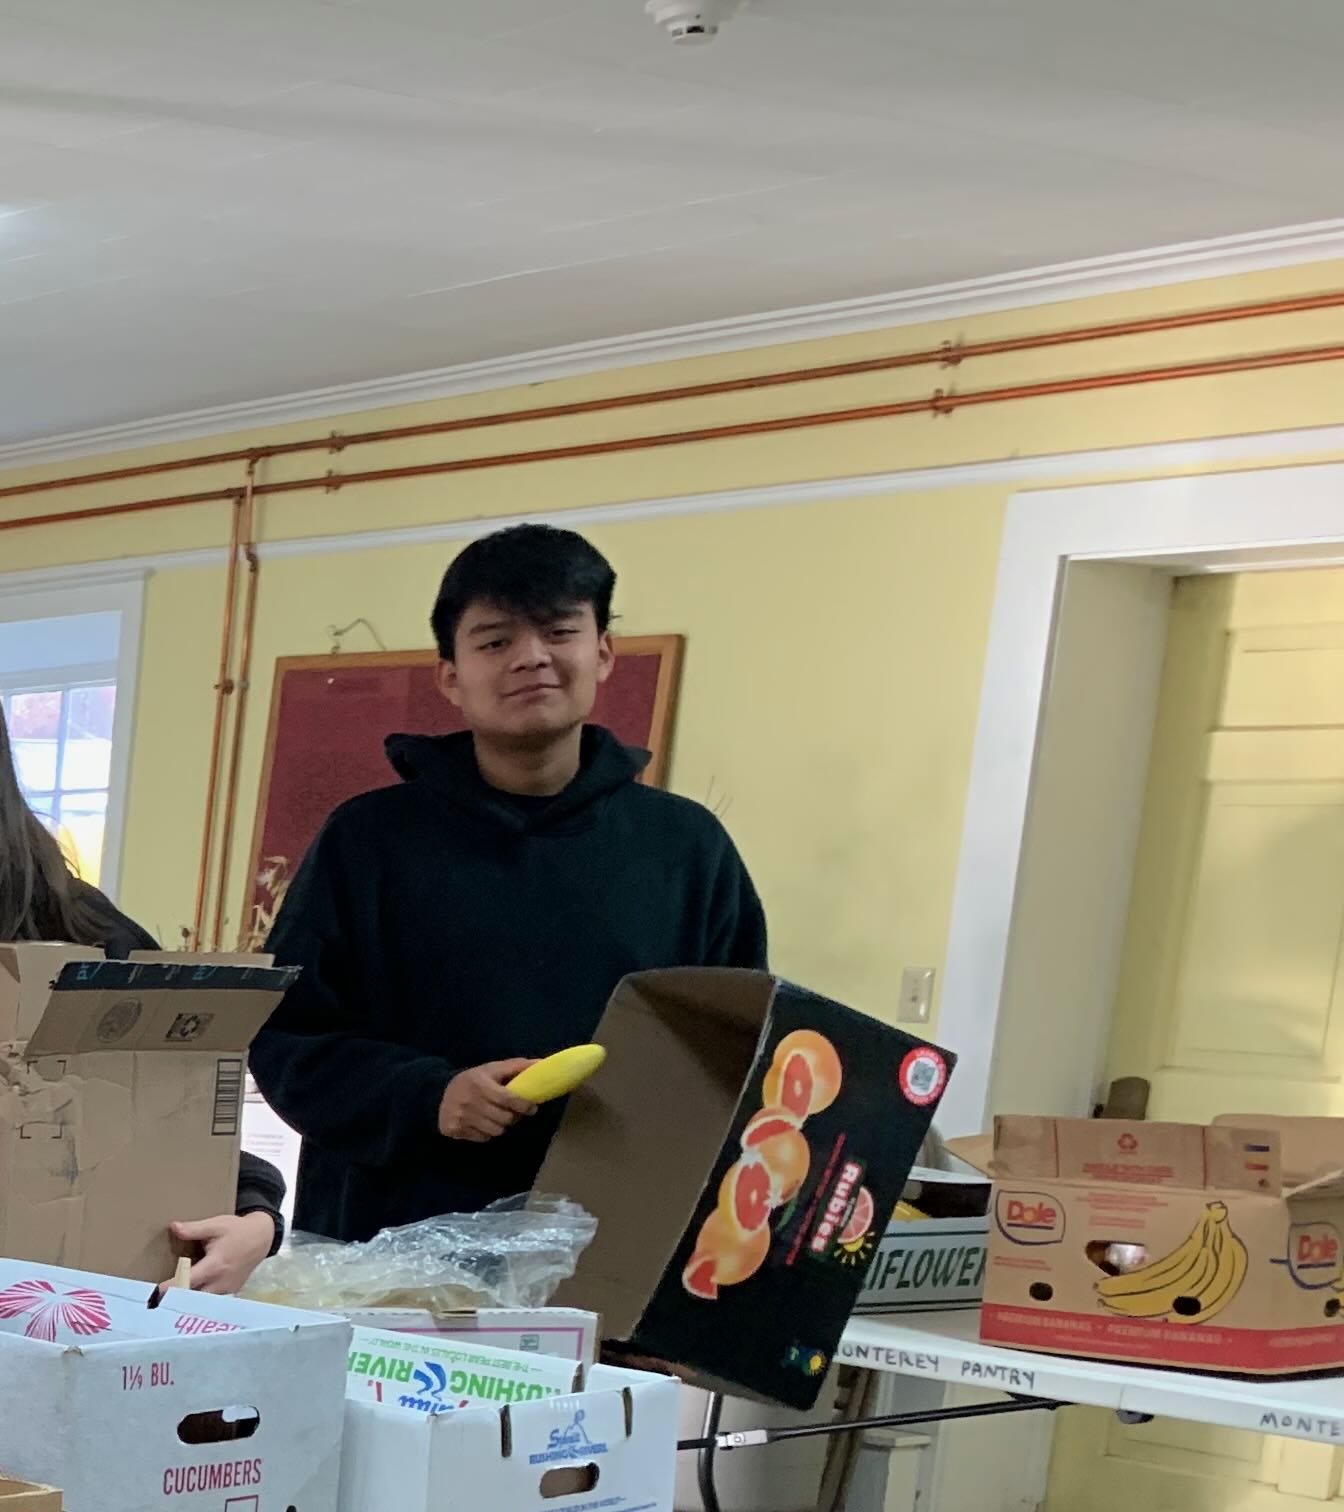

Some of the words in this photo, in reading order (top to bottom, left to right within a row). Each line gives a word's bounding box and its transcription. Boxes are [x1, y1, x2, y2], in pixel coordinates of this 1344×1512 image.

[1007, 1200, 1057, 1224] Dole
[1297, 1234, 1338, 1260] Dole
[150, 1362, 175, 1386] BU.
[960, 1358, 1037, 1390] PANTRY
[1259, 1412, 1344, 1438] MONTE
[162, 1458, 263, 1496] CUCUMBERS
